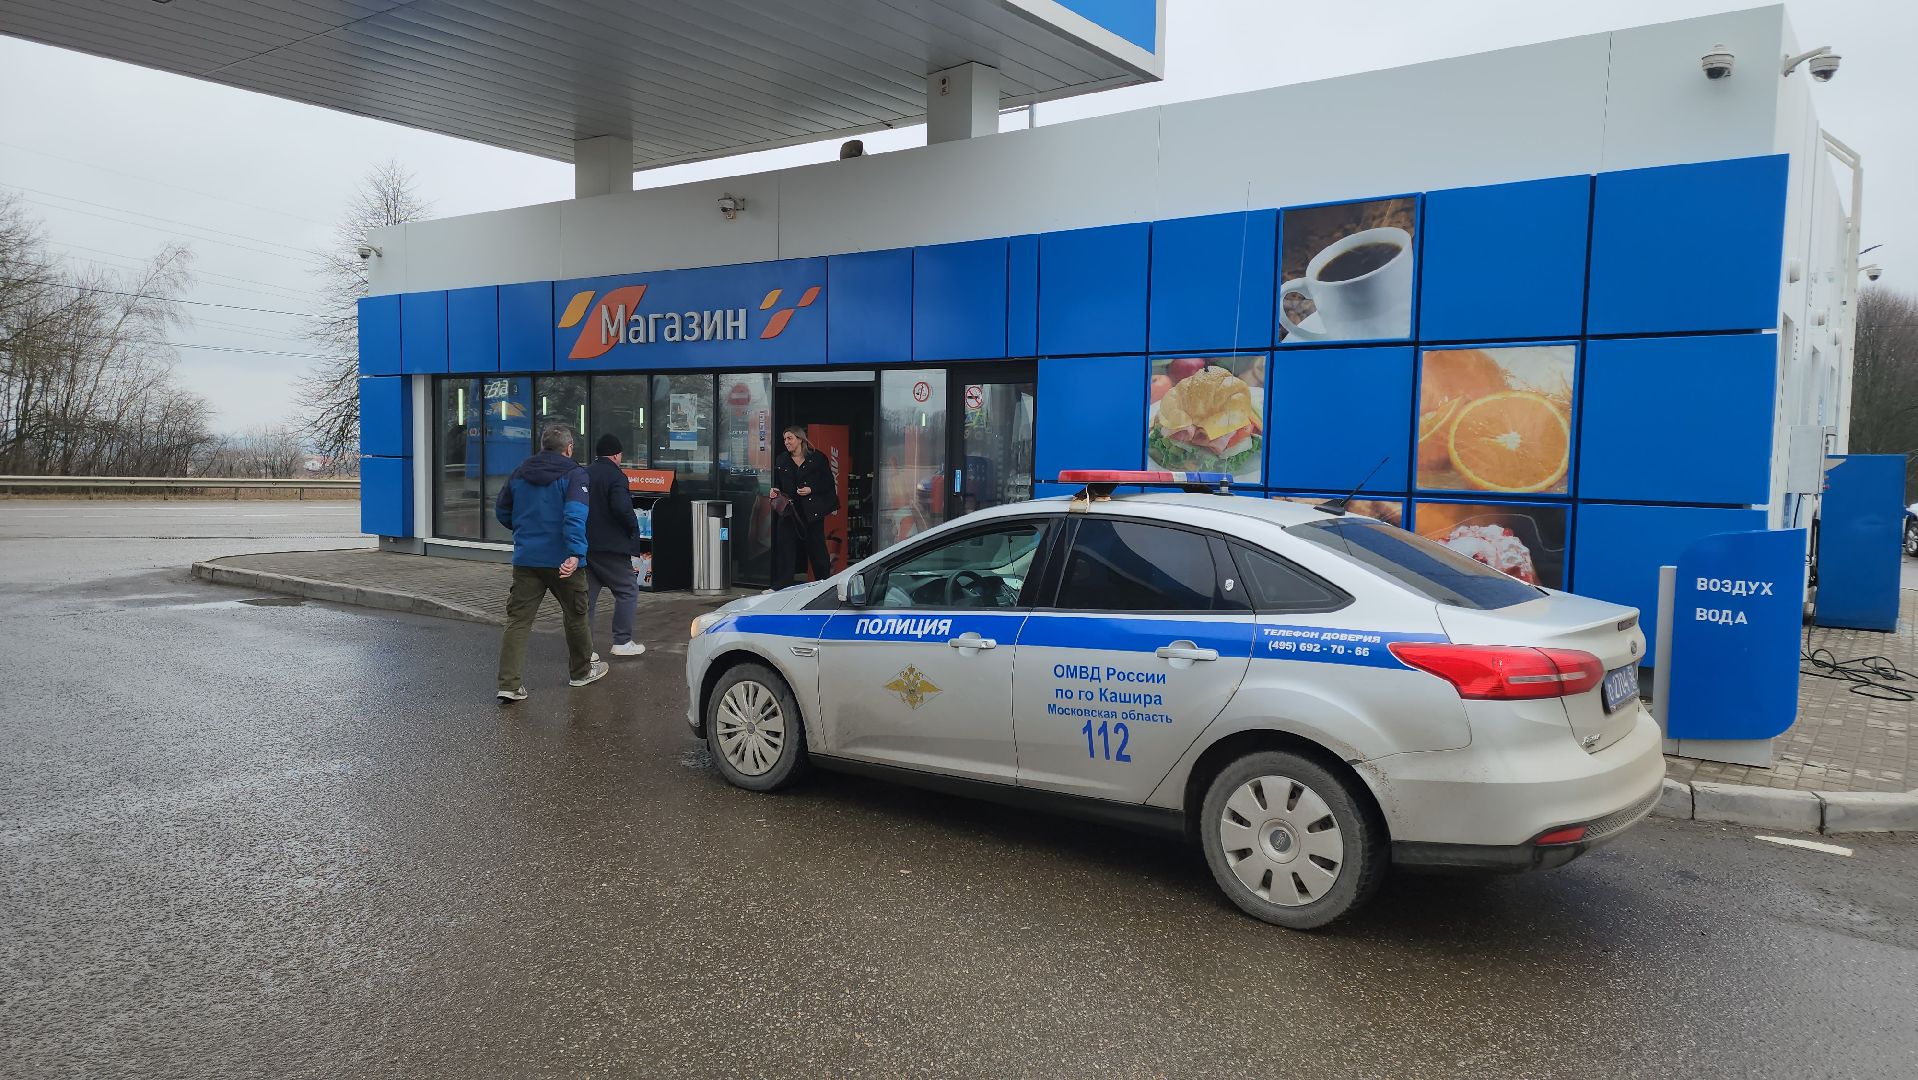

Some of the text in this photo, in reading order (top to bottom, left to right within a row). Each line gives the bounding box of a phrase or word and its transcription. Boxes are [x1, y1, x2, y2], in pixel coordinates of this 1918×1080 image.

[601, 304, 747, 345] Магазин
[1696, 577, 1774, 597] ВОЗДУХ
[1696, 607, 1748, 625] ВОДА
[855, 618, 953, 638] ПОЛИЦИЯ
[1263, 629, 1381, 643] ТЕЛЕФОН ДОВЕРИЯ
[1268, 640, 1297, 652] (495)
[1299, 643, 1321, 653] 692
[1330, 645, 1345, 655] 70
[1354, 647, 1370, 657] 66
[1053, 664, 1166, 684] ОМВД России
[1055, 687, 1163, 708] по го Кашира
[1047, 703, 1173, 724] Московская область
[1082, 719, 1132, 763] 112
